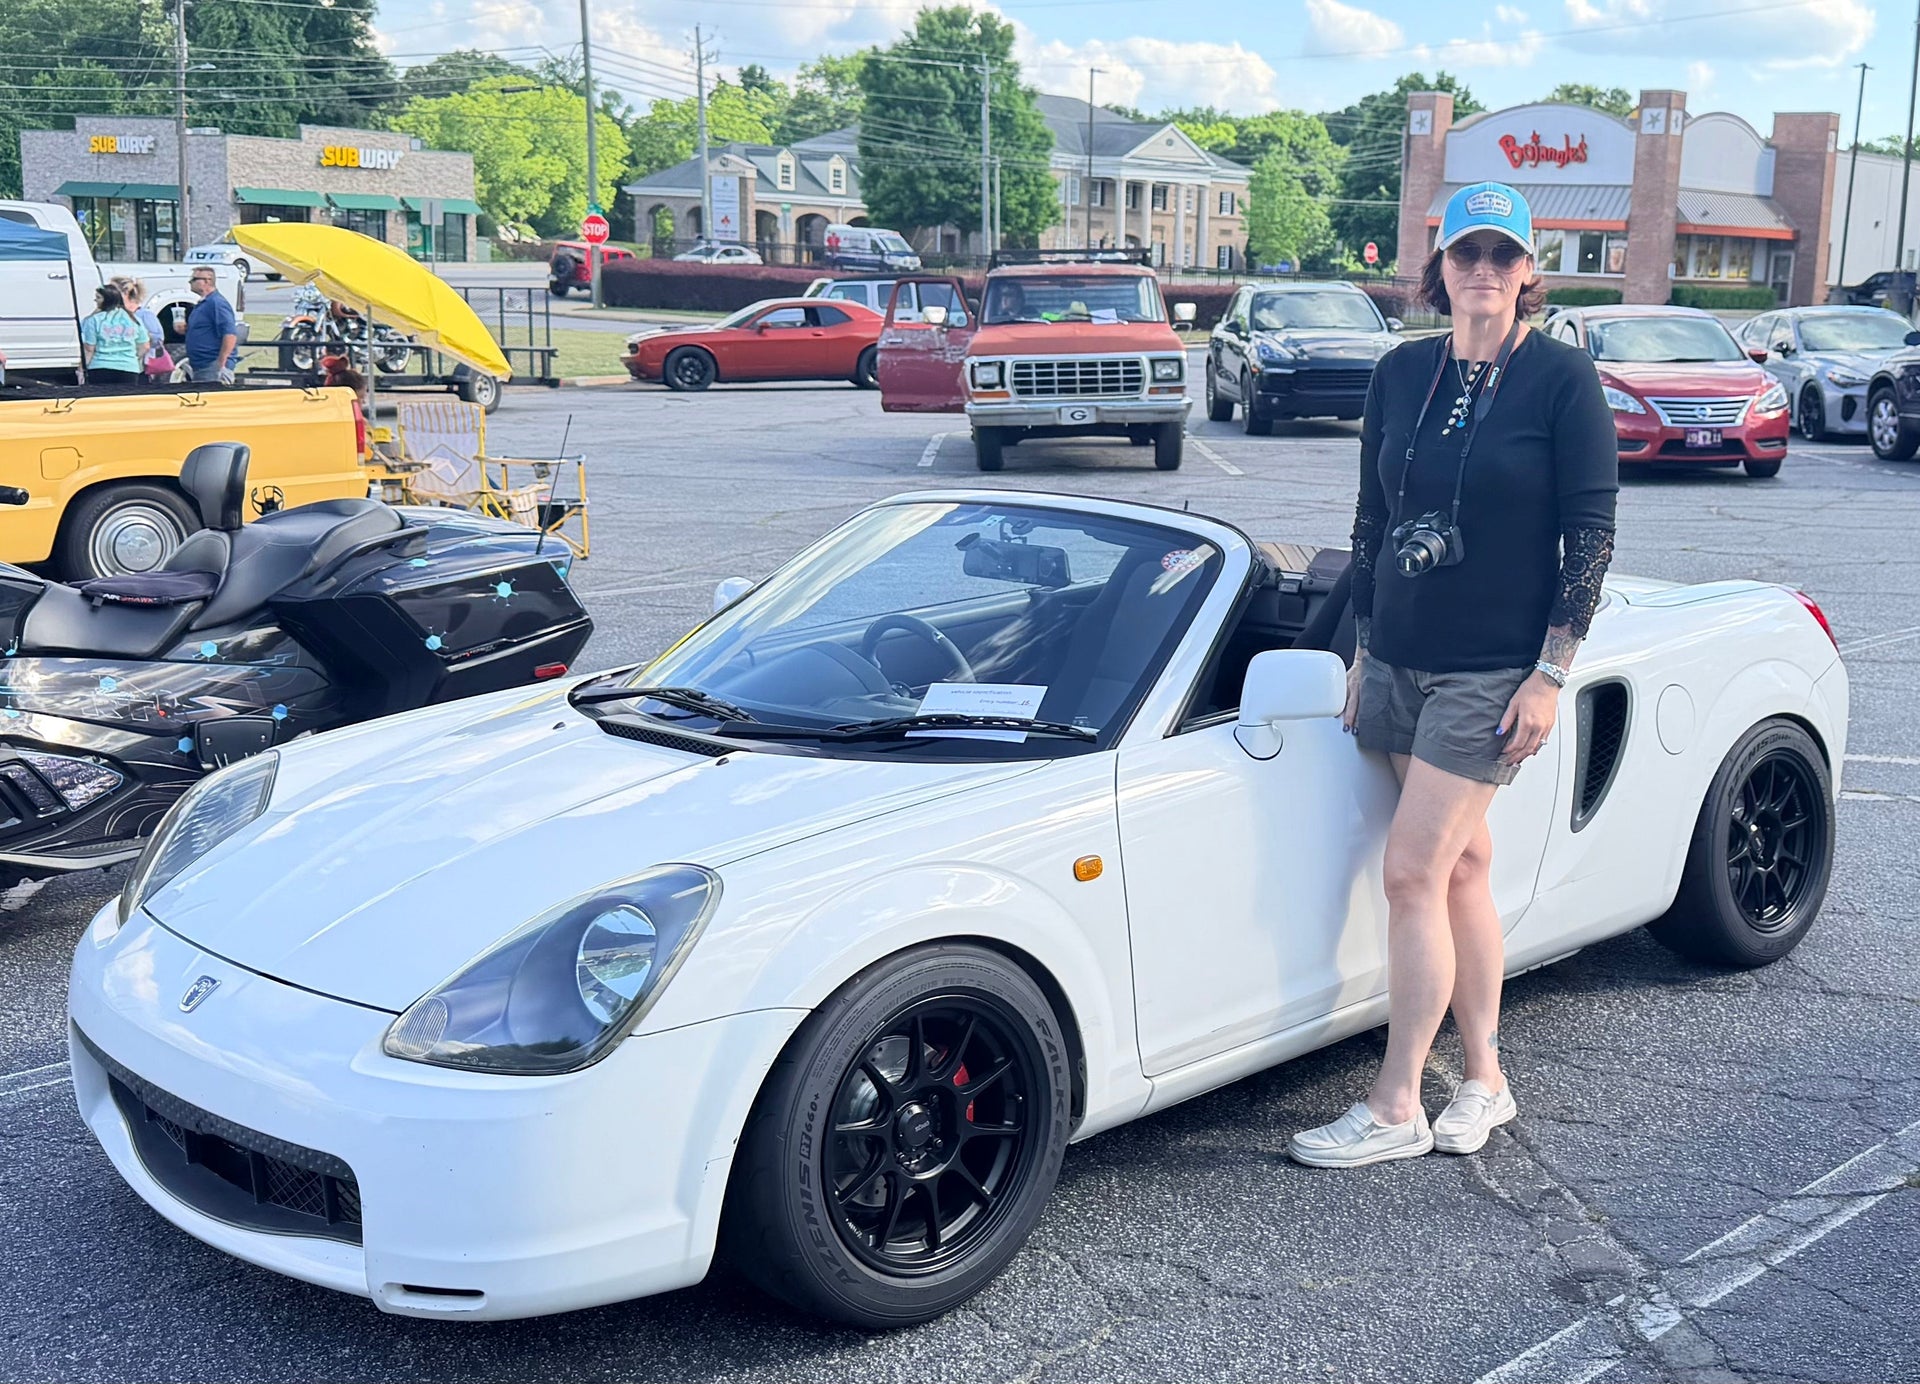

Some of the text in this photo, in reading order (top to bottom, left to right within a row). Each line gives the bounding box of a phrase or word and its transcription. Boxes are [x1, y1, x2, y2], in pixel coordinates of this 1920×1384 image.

[88, 135, 154, 154] SUBWAY
[320, 146, 404, 169] SUBWAY
[584, 223, 607, 236] STOP
[1070, 410, 1088, 421] G
